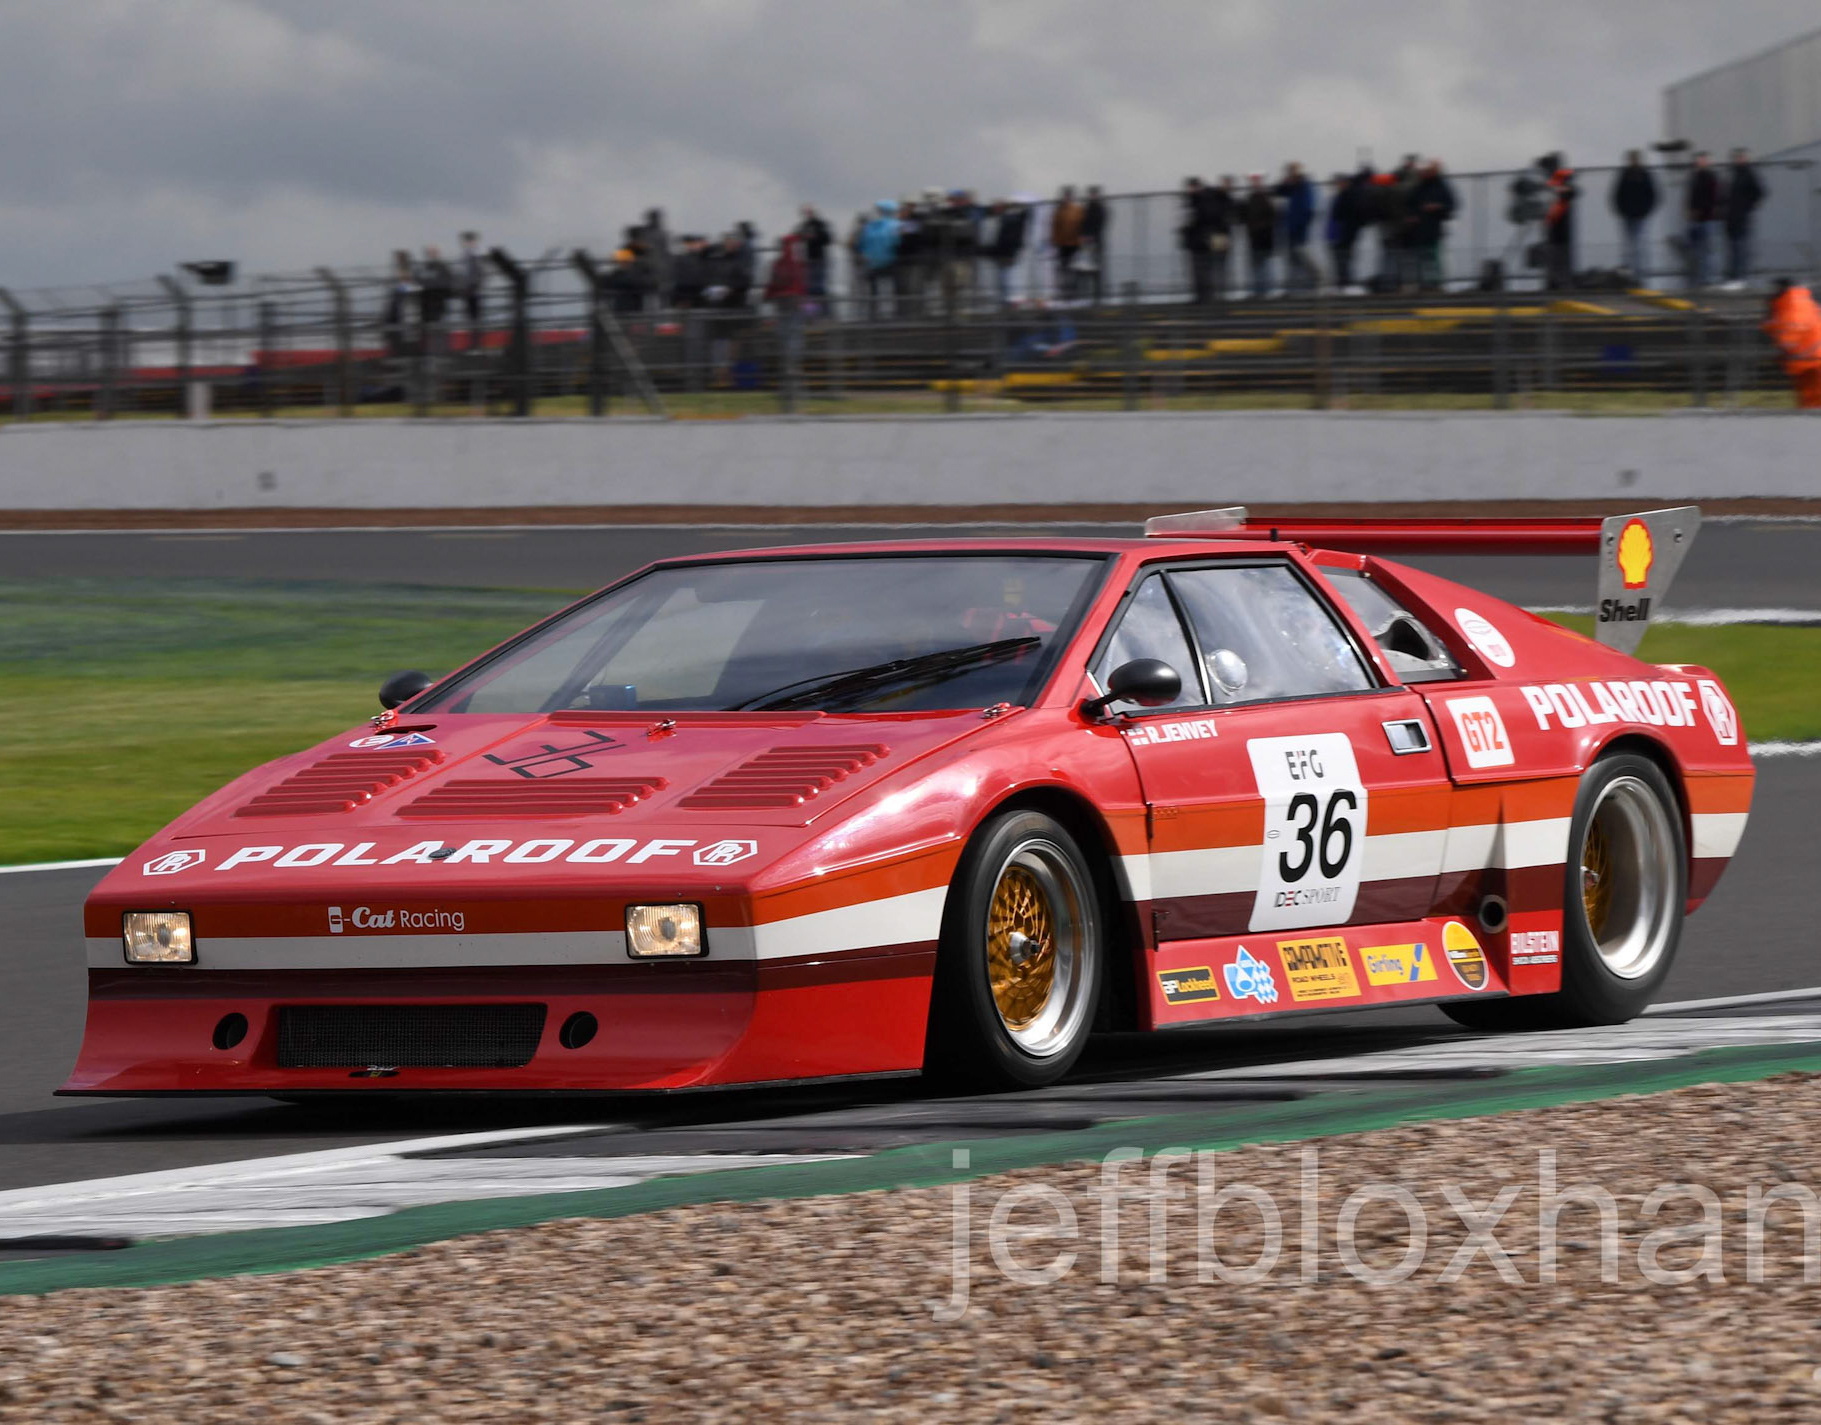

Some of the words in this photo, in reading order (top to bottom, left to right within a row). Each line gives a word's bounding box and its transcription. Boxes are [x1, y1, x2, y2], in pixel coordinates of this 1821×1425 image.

[1600, 598, 1651, 622] Shell
[1520, 681, 1698, 731] POLAROOF
[1461, 711, 1504, 752] GT2
[1285, 749, 1324, 780] EFG
[1279, 788, 1357, 883] 36
[214, 839, 698, 871] POLAROOF
[1301, 887, 1342, 905] SPORT
[400, 909, 465, 931] Racing
